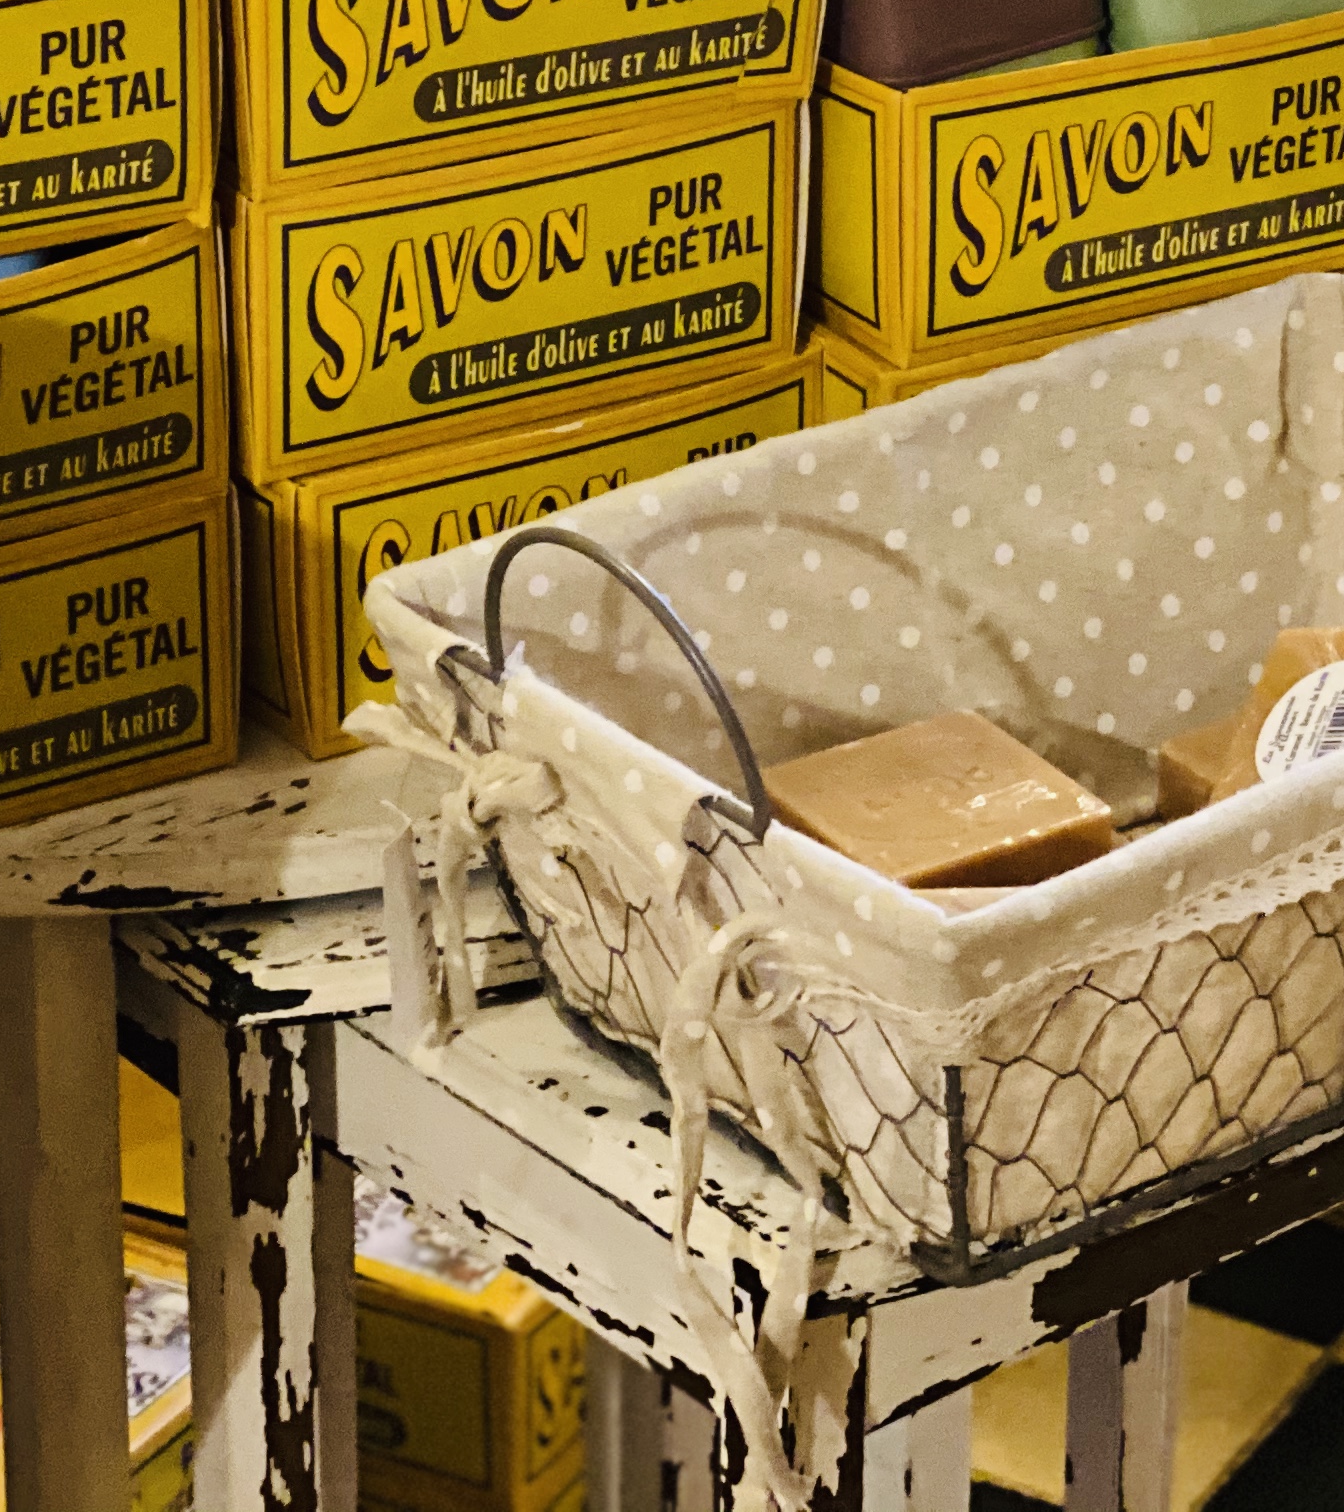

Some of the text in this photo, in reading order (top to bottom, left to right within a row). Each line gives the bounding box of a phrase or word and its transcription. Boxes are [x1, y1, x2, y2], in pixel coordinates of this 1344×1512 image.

[41, 18, 128, 76] PUR
[1270, 74, 1343, 127] PUR
[648, 171, 723, 227] PUR
[951, 101, 1214, 298] SAVON
[605, 214, 764, 287] VÉGÉTAL
[69, 305, 151, 363] PUR
[306, 204, 588, 411] SAVON
[21, 344, 194, 425] VÉGÉTAL
[67, 576, 150, 635] PUR
[21, 617, 198, 697] VÉGÉTAL
